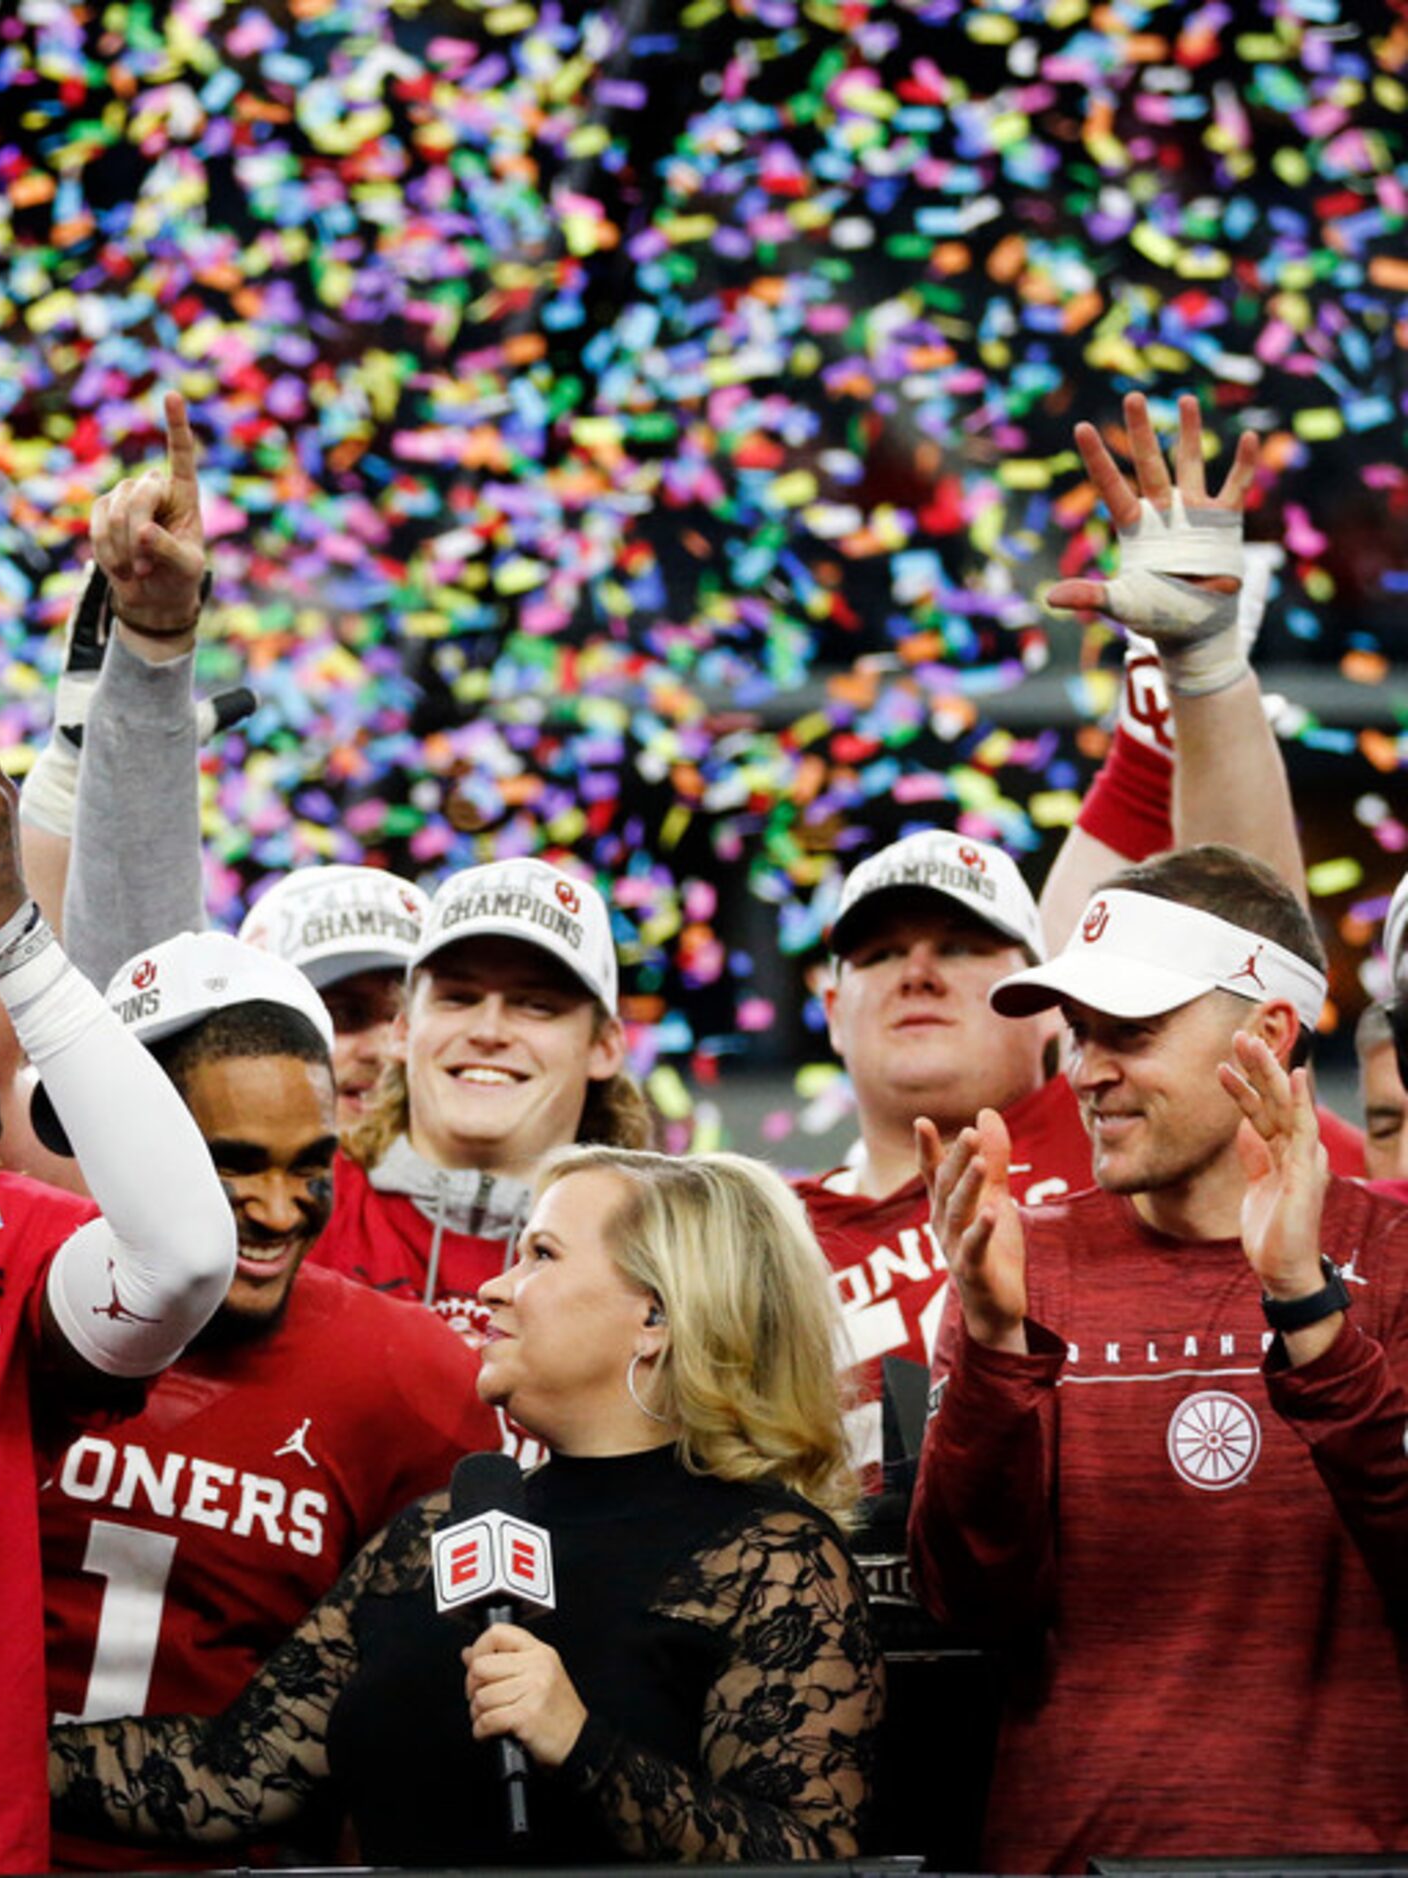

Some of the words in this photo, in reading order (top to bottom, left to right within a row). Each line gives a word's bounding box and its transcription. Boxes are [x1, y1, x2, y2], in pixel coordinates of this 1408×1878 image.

[302, 909, 422, 946] CHAMPION
[442, 893, 584, 949] CHAMPIONS
[42, 1436, 328, 1556] ONERS
[53, 1519, 179, 1725] 1
